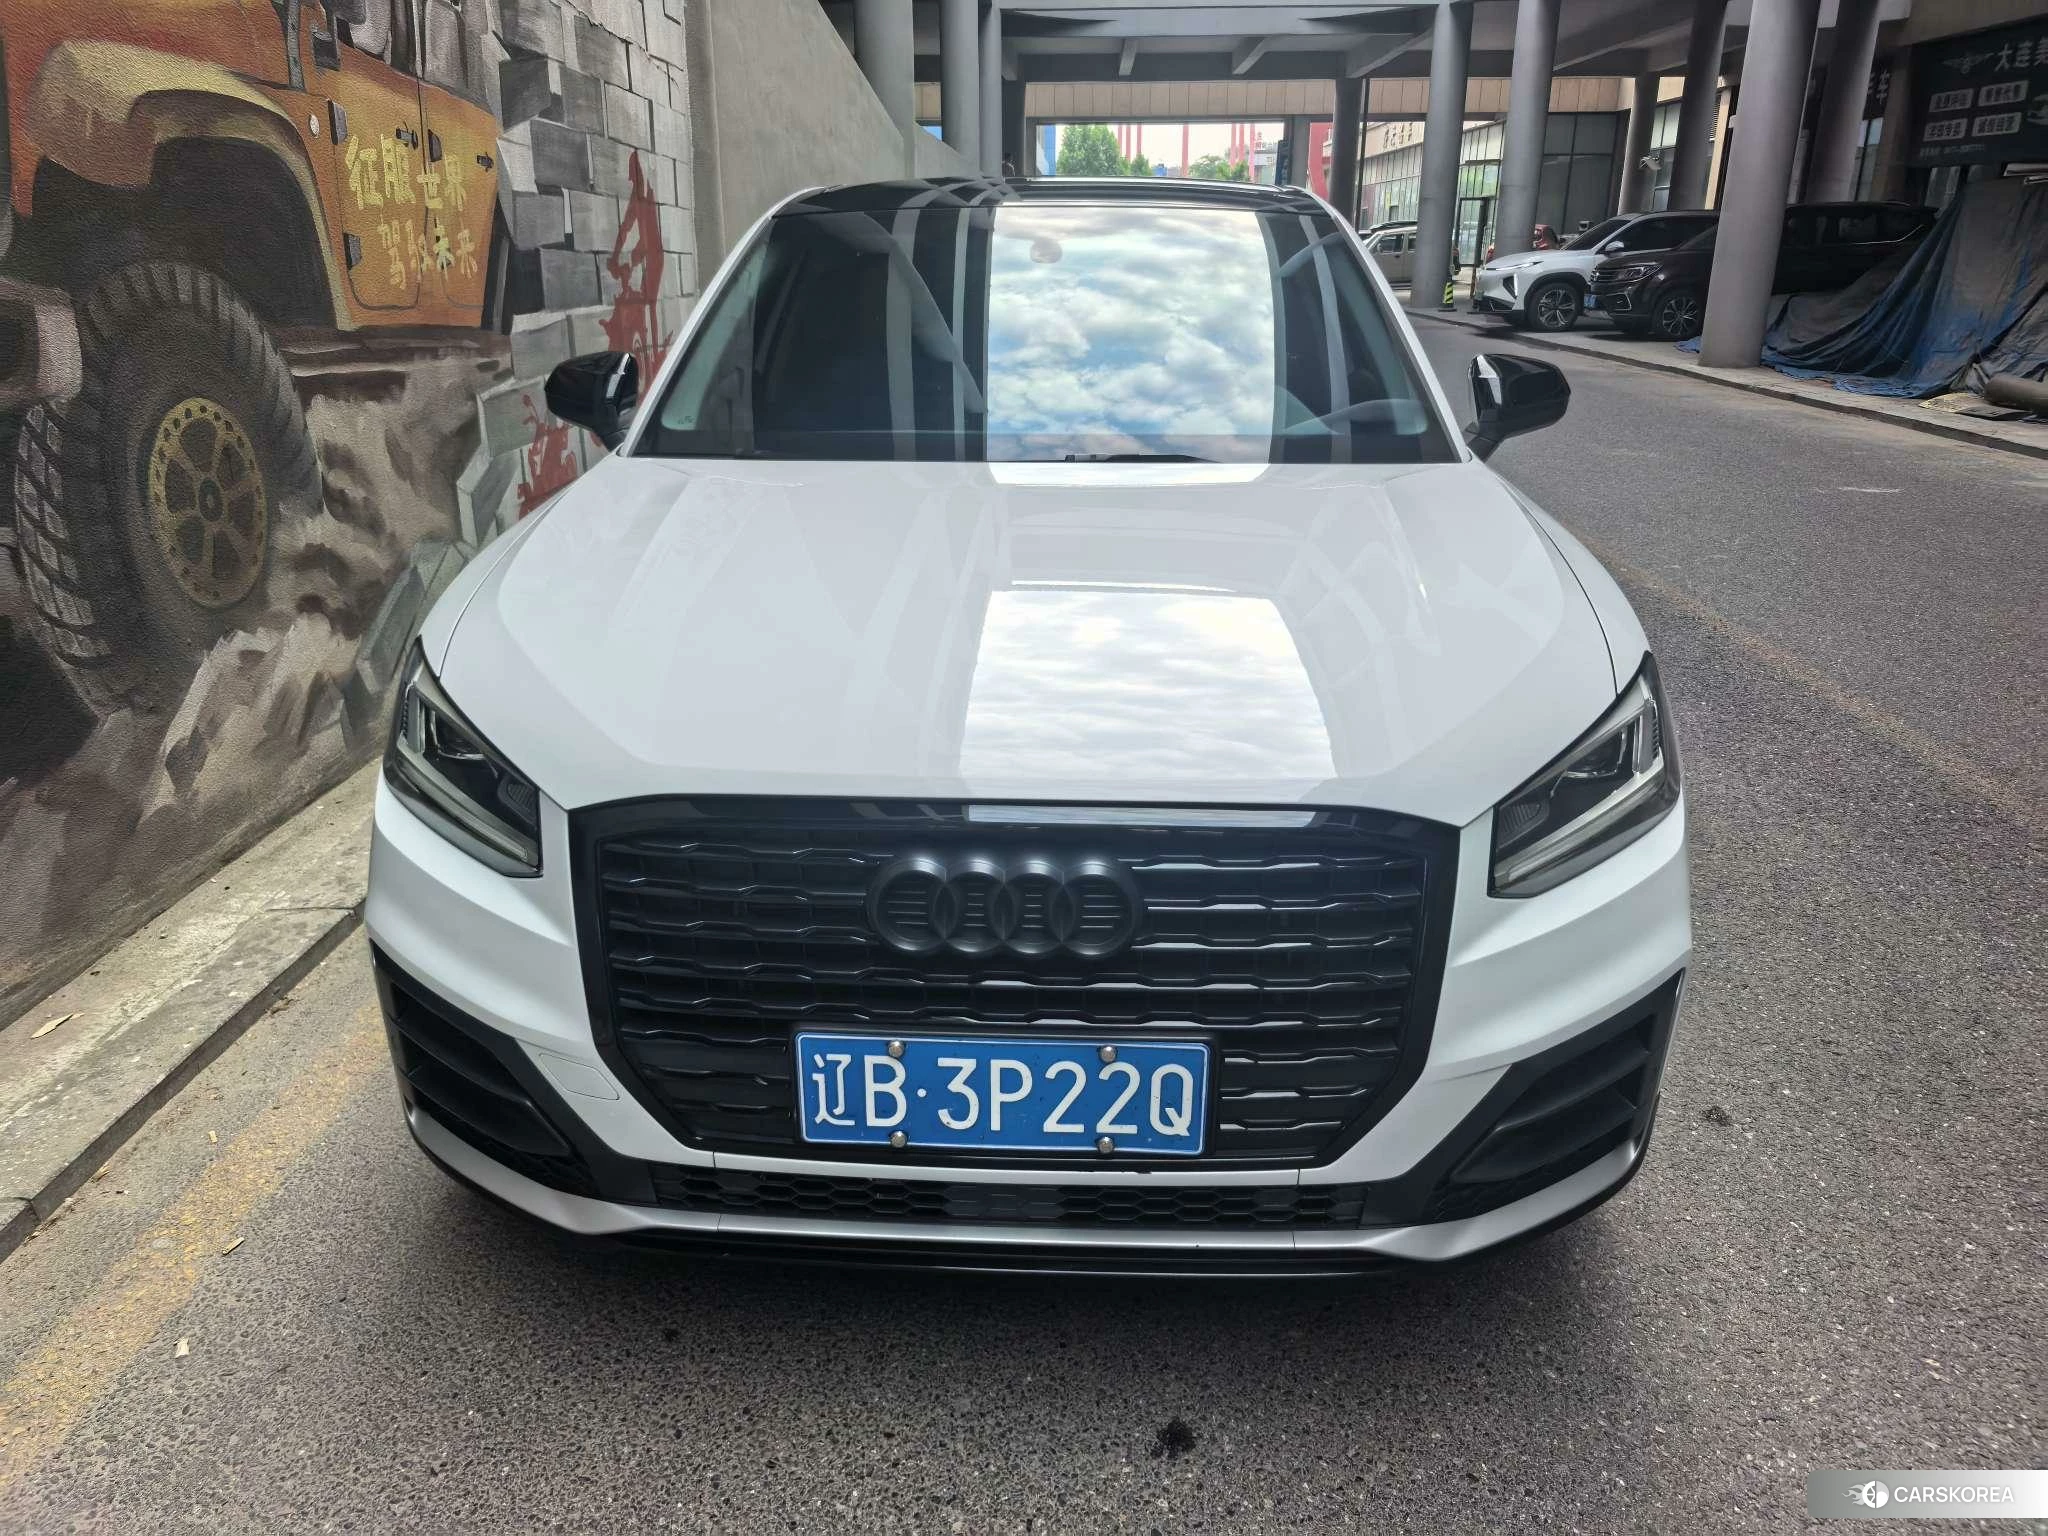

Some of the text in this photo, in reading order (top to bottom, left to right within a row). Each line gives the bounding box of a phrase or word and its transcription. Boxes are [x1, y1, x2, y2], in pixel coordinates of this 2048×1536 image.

[345, 133, 467, 211] 征服世界
[377, 218, 477, 289] 驾驭未来
[811, 1053, 1195, 1137] 辽B·3P22Q
